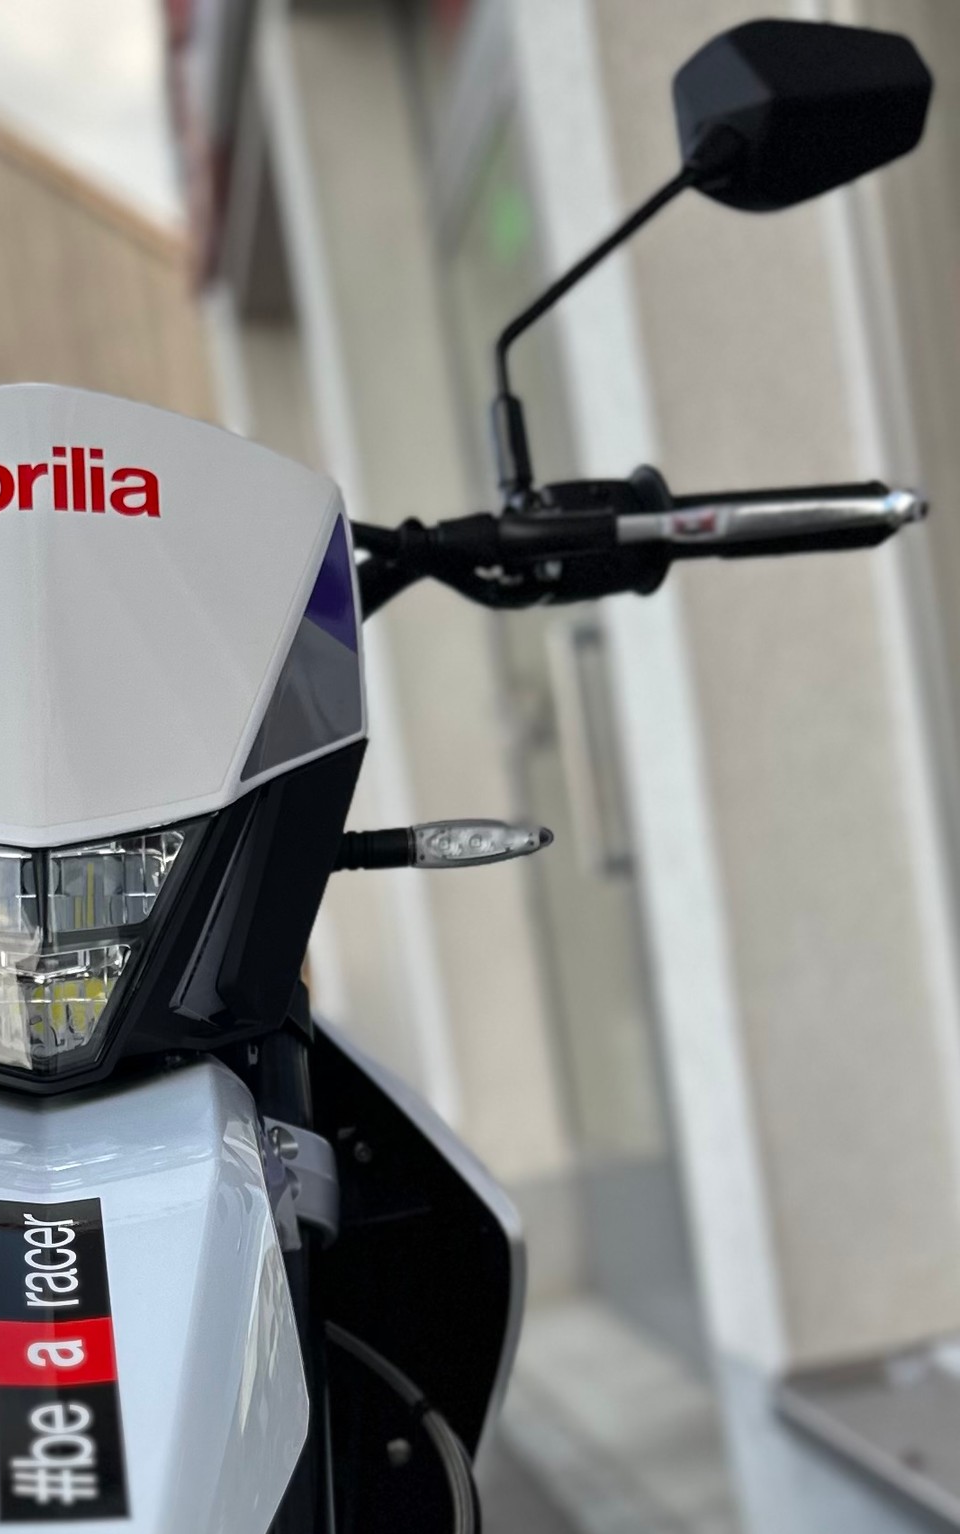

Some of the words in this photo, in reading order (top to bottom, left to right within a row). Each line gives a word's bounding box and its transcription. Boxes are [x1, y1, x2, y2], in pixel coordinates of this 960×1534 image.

[22, 1212, 80, 1308] racer
[26, 1338, 86, 1369] a
[10, 1402, 97, 1505] #be
